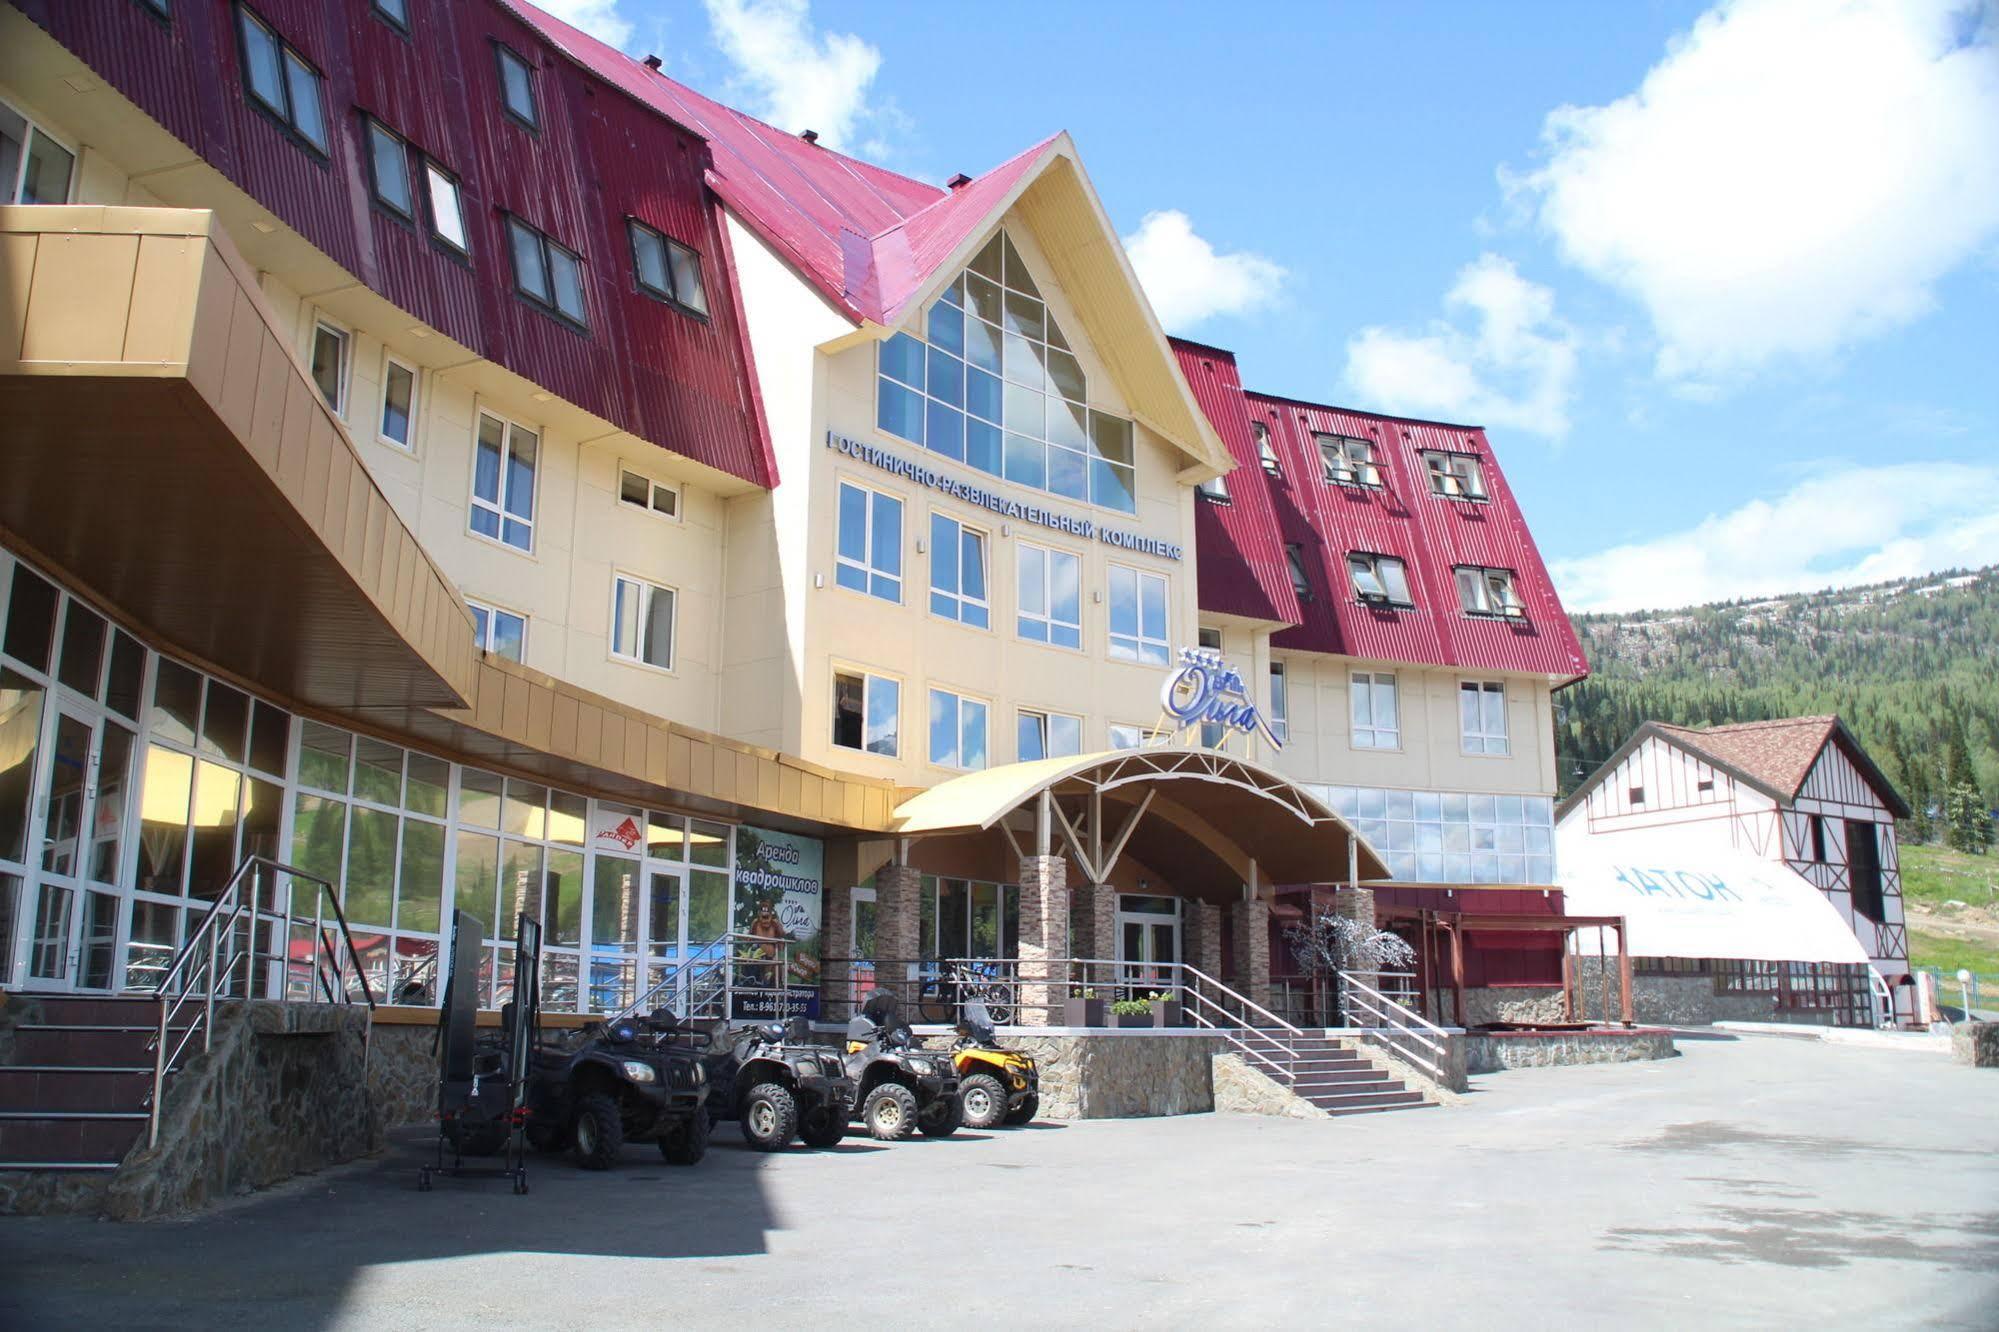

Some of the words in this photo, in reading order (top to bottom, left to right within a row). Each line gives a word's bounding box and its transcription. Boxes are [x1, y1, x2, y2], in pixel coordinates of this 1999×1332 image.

[827, 430, 1094, 538] ГОСТИНИЧНО-РАЗВЛЕКАТЕЛЬНЫЙ
[1100, 527, 1184, 561] КОМПЛЕКС
[756, 840, 800, 865] Аренда
[735, 868, 819, 895] квадроциклов
